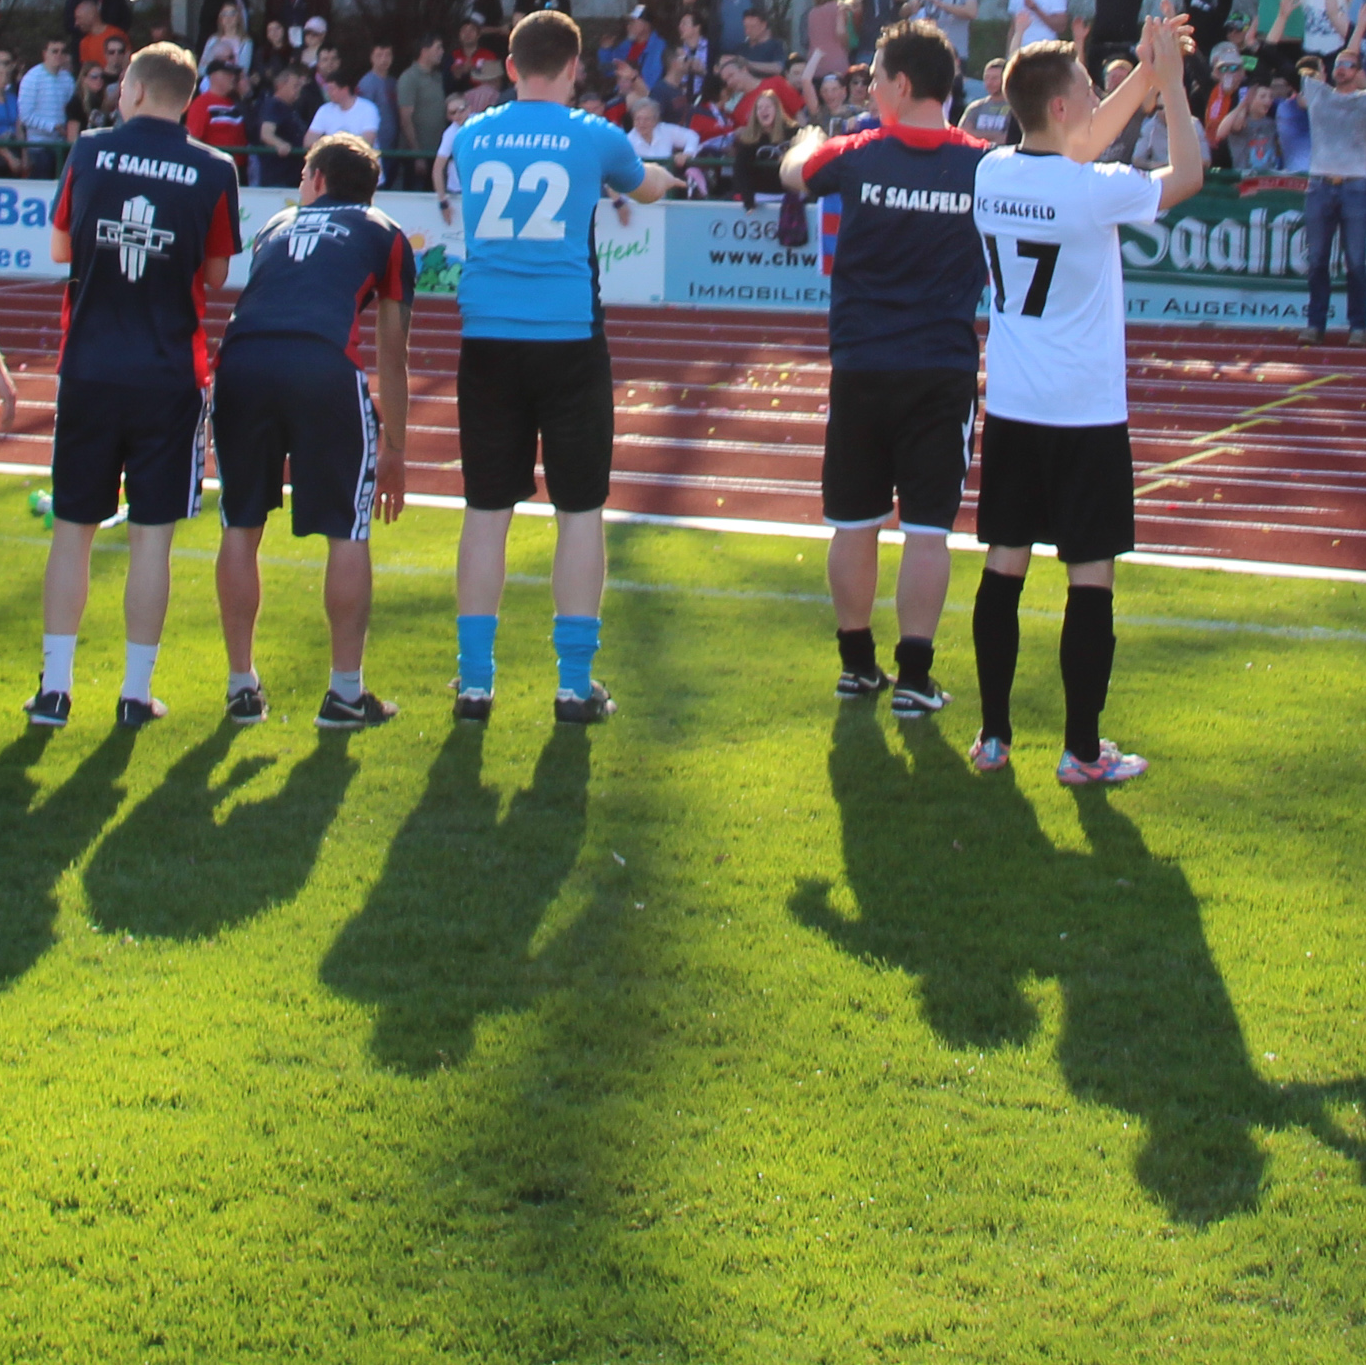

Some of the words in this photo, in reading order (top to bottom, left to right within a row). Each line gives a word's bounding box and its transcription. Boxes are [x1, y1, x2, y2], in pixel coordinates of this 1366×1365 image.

[472, 135, 490, 150] FC
[495, 134, 571, 151] SAALFELD
[95, 150, 116, 170] FC
[117, 153, 199, 185] SAALFELD
[470, 160, 570, 240] 22
[861, 182, 882, 205] FC
[884, 186, 973, 214] SAALFELD
[993, 200, 1056, 221] SAALFELD
[985, 234, 1061, 319] 17
